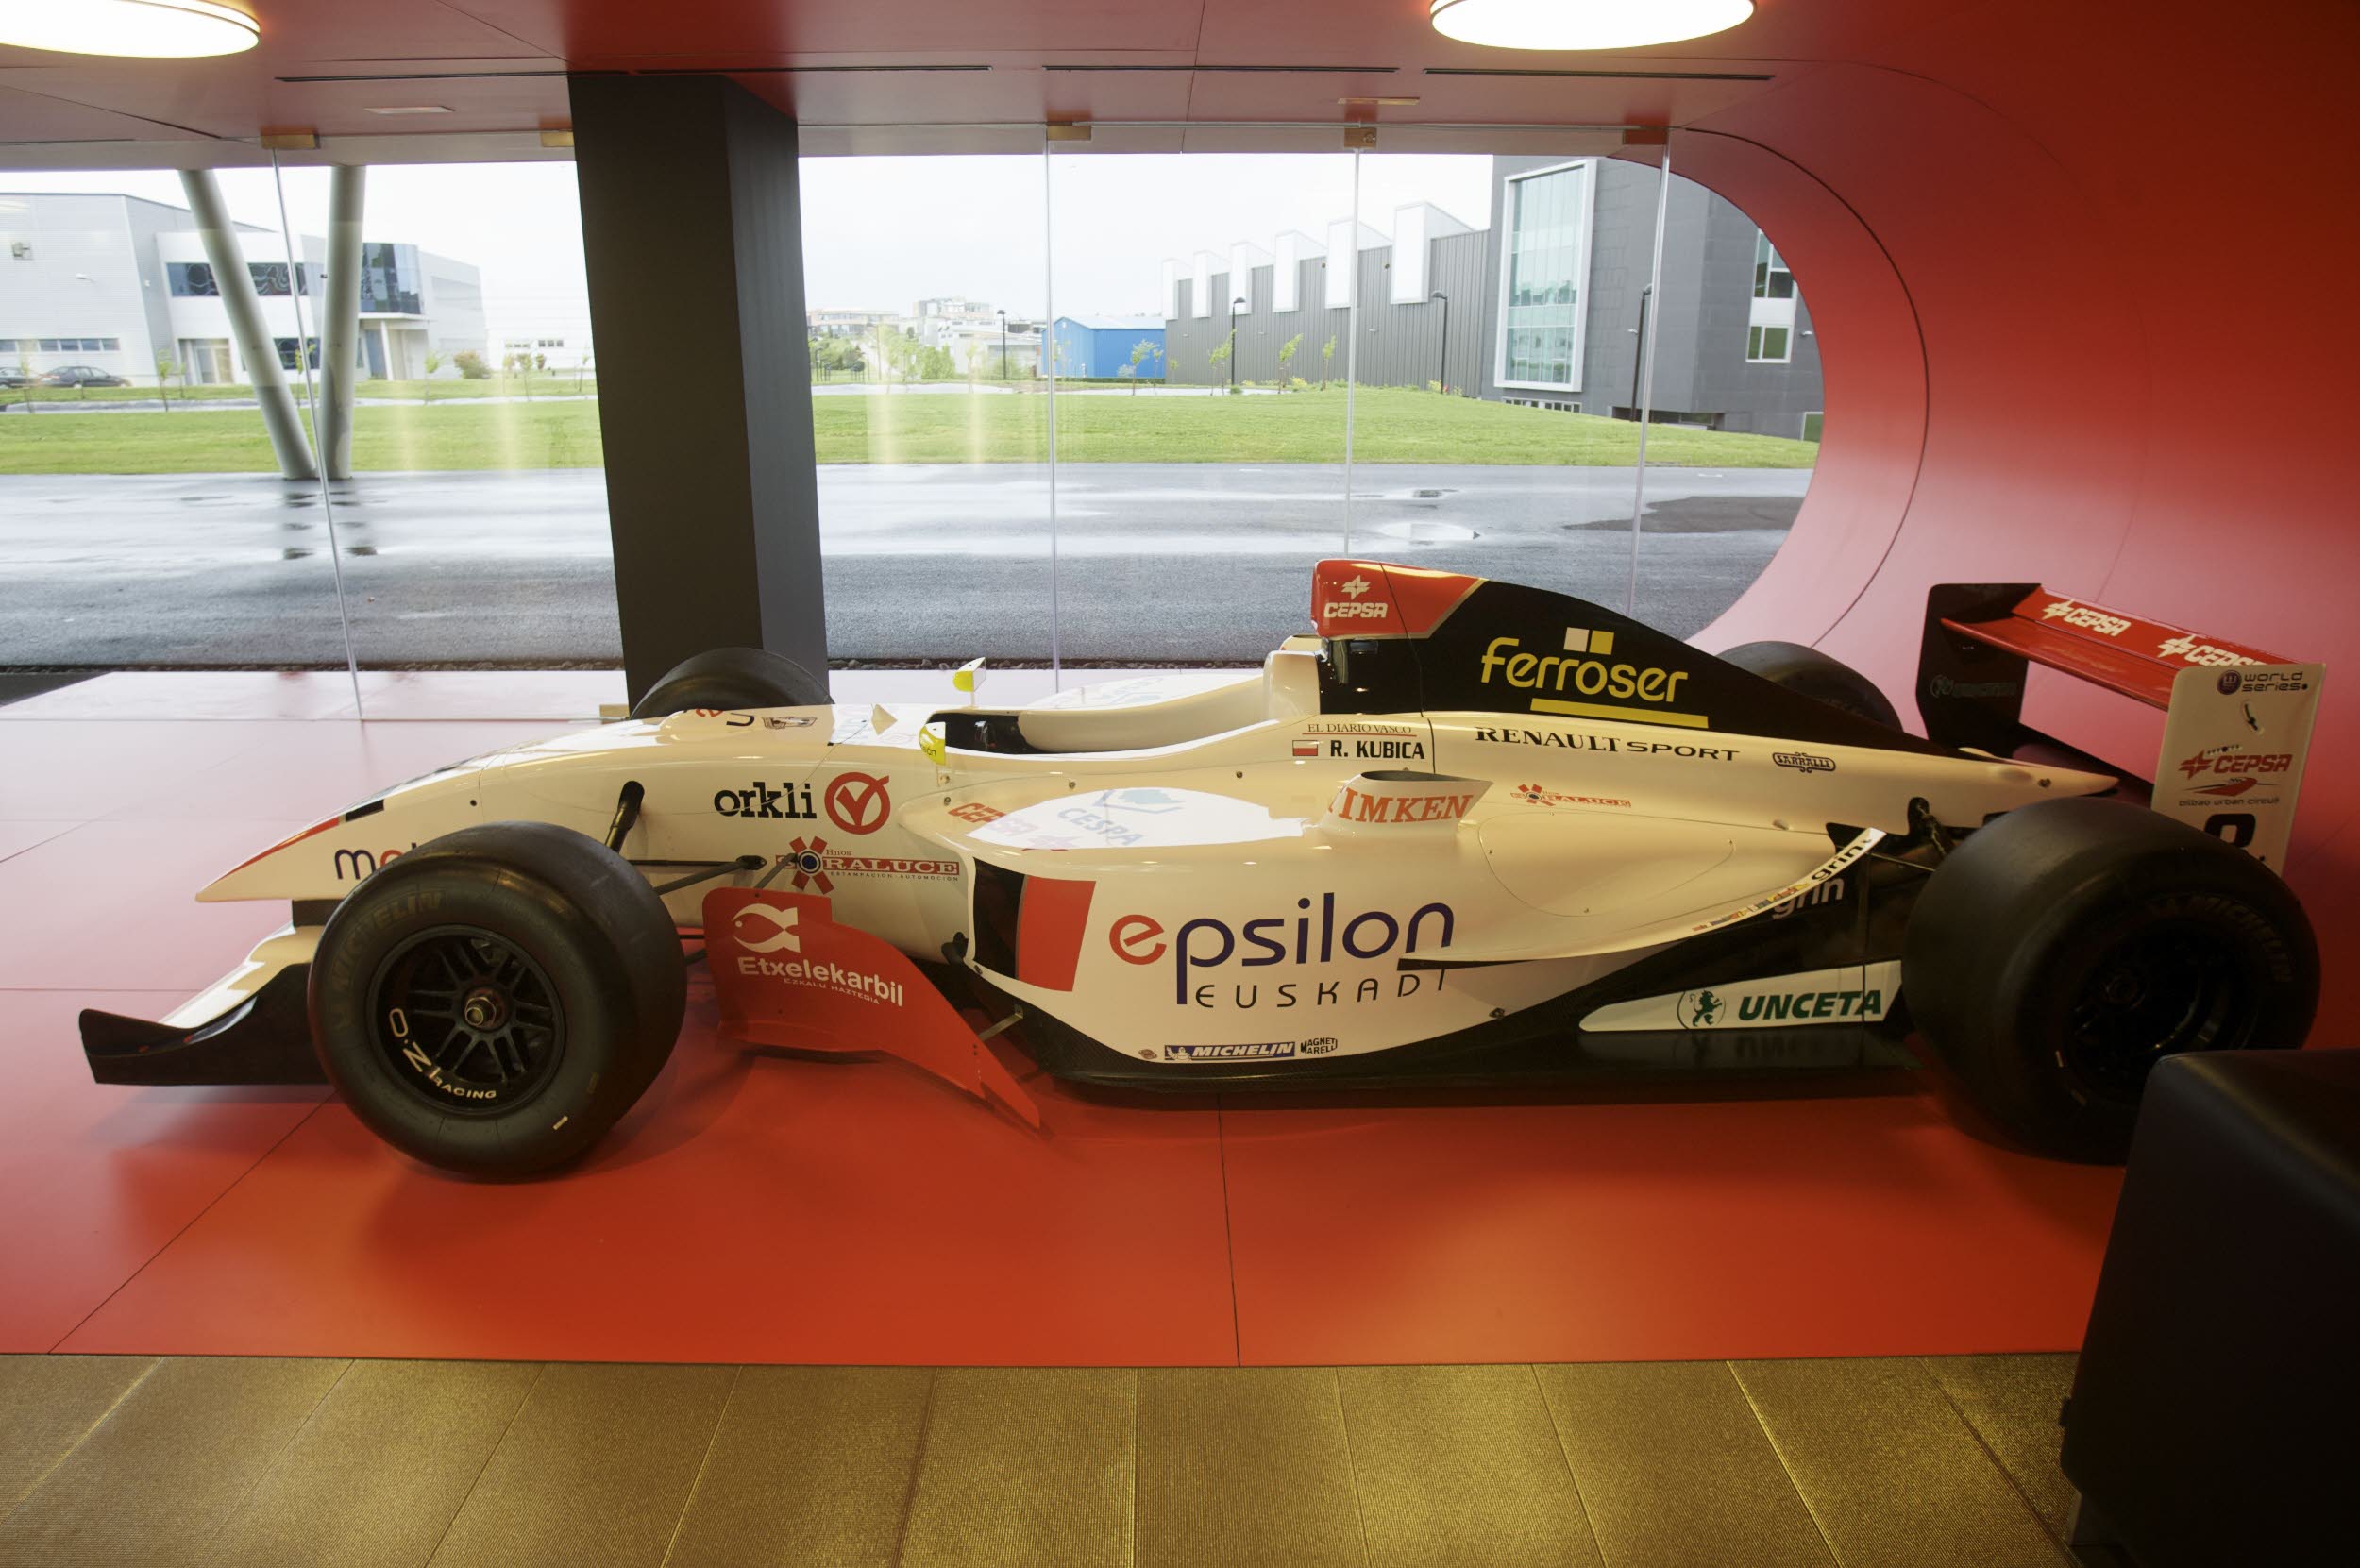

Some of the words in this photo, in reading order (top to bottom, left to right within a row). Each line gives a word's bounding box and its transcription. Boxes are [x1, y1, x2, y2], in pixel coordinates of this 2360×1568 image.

[1323, 602, 1388, 618] CEPSA
[2063, 607, 2132, 637] CEPSA
[1481, 636, 1688, 702] ferroser
[2184, 645, 2269, 666] CEP
[2244, 671, 2303, 682] world
[1307, 723, 1325, 733] EL
[1327, 723, 1371, 733] DIARIO
[1371, 724, 1412, 734] VASCO
[1475, 726, 1622, 752] RENAULT
[1627, 741, 1740, 762] SPORT
[1330, 739, 1349, 758] R.
[1357, 739, 1425, 760] KUBICA
[2213, 753, 2294, 774] CEPSA
[714, 781, 818, 819] orkli
[1327, 786, 1474, 824] IMKEN
[1057, 807, 1144, 846] CESPA
[1811, 845, 1864, 882] grin
[1108, 891, 1455, 1004] epsilon
[738, 955, 903, 1007] Etxelekarbil
[1194, 969, 1446, 1009] EUSKADI
[1738, 990, 1881, 1021] UNCETA
[1192, 1041, 1294, 1058] MICHELIN
